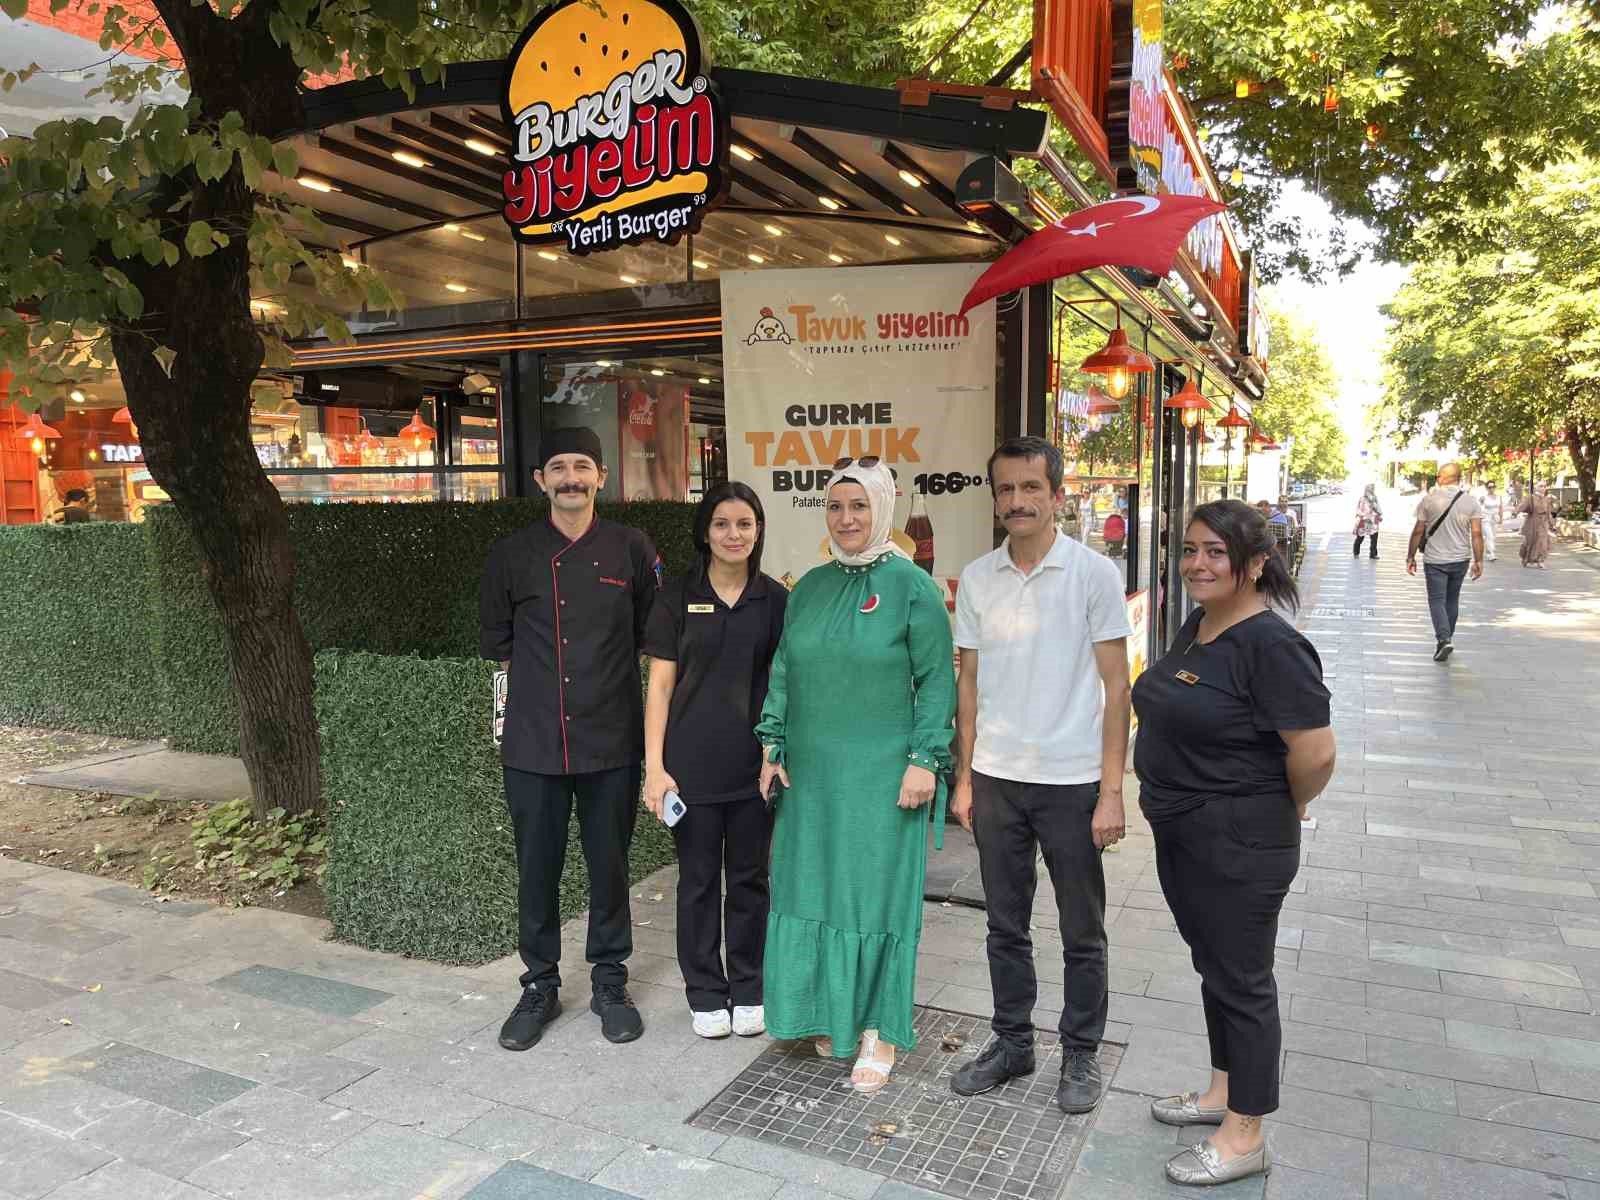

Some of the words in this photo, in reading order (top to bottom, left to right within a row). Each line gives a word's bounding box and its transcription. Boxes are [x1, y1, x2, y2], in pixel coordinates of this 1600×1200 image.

[877, 311, 970, 340] yiyelim
[785, 402, 892, 427] GURME
[745, 427, 921, 467] TAVUK
